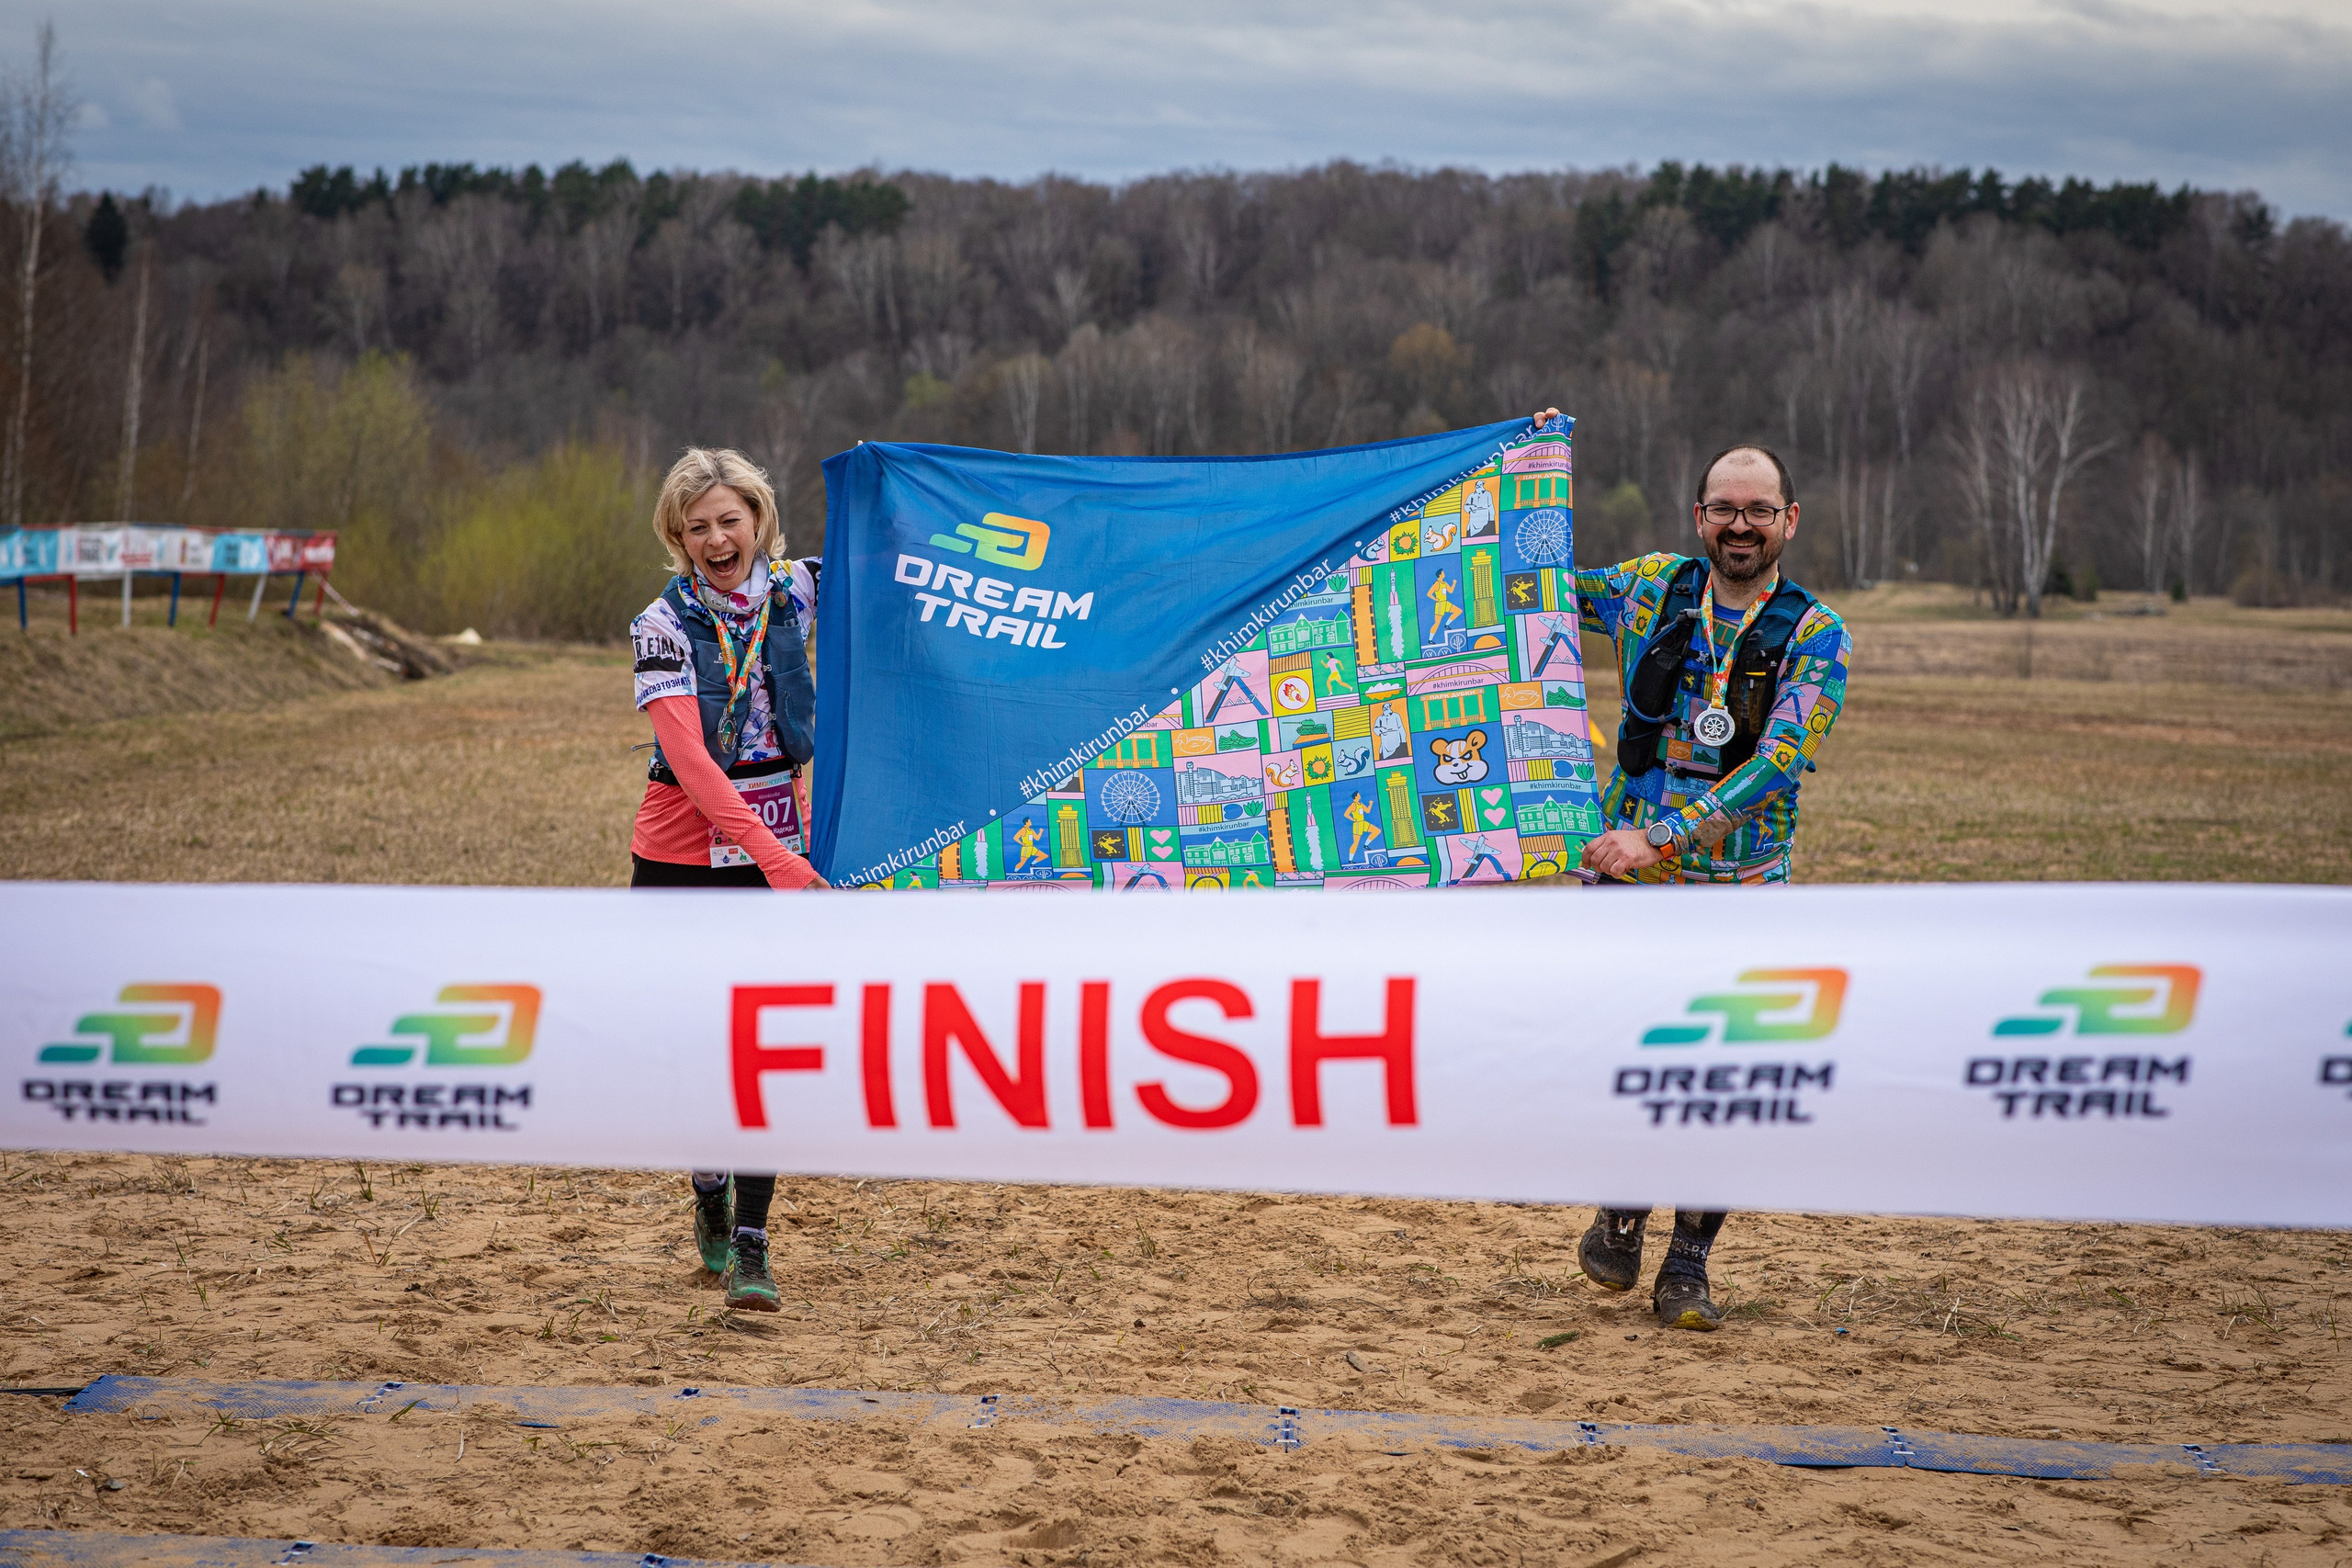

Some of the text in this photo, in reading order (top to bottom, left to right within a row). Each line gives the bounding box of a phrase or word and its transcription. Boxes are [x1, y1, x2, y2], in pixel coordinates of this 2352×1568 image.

[894, 553, 1094, 620] DREAM
[914, 592, 1067, 649] TRAIL
[1200, 558, 1332, 671] #khimkirunbar
[1432, 678, 1484, 689] #khimkirunbar
[1451, 690, 1476, 698] ДУБКИ
[1019, 704, 1151, 799] #khimkirunbar
[1529, 782, 1581, 790] #khimkirunbar
[774, 825, 795, 834] Надежда
[1198, 821, 1250, 832] #khimkirunbar
[729, 977, 1418, 1131] FINISH
[1612, 1061, 1834, 1096] DREAM
[1966, 1055, 2190, 1088] DREAM
[22, 1080, 218, 1104] DREAM
[330, 1083, 532, 1109] DREAM
[1993, 1088, 2169, 1120] TRAIL
[52, 1102, 210, 1126] TRAIL
[361, 1108, 519, 1132] TRAIL
[1643, 1096, 1813, 1126] TRAIL
